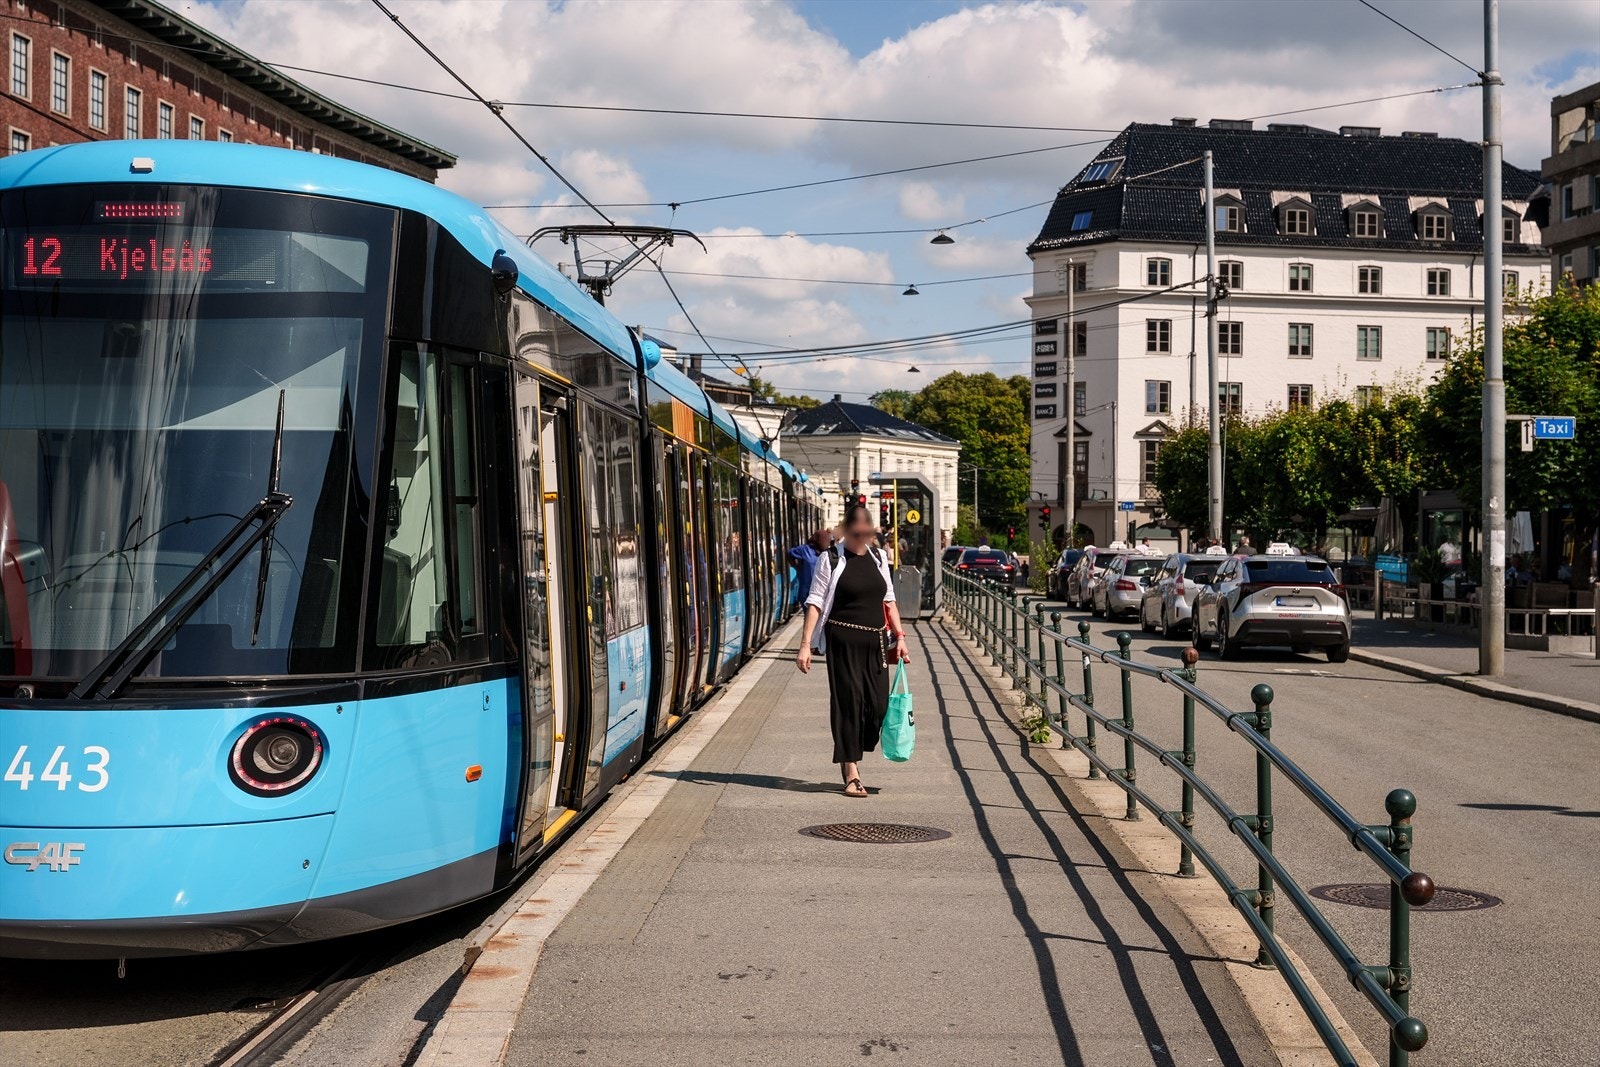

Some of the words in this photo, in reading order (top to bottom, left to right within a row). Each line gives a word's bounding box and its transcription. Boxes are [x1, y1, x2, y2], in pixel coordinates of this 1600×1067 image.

[23, 237, 62, 275] 12
[100, 238, 213, 280] Kjelsås
[1540, 421, 1568, 434] Taxi
[4, 745, 110, 792] 443
[4, 842, 86, 872] CAF
